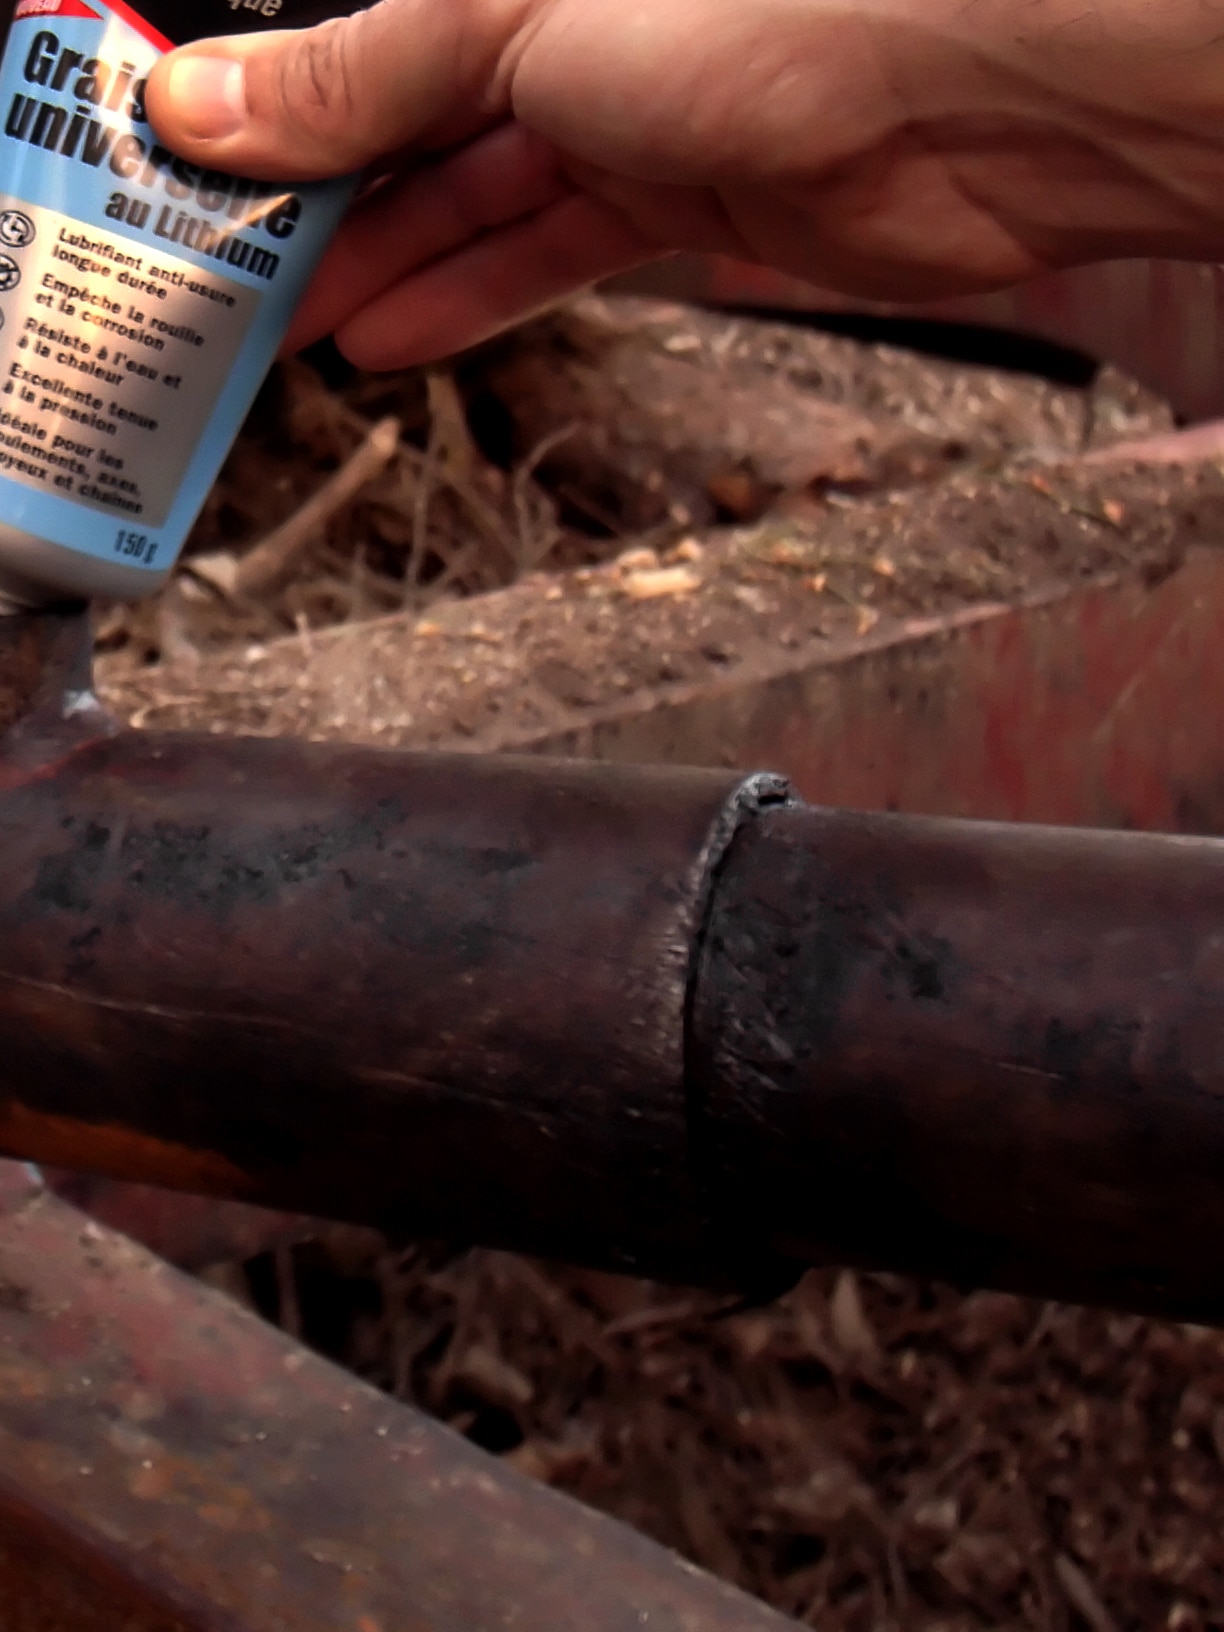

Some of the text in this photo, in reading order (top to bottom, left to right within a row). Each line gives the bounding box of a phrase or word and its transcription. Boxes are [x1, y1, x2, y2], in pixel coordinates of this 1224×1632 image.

[23, 30, 148, 124] Grais
[104, 192, 152, 230] au
[52, 244, 168, 300] longue durée
[59, 226, 236, 308] Lubrifiant anti-usure
[35, 291, 166, 351] et la corrosion
[42, 273, 205, 348] Empêche la rouille
[16, 335, 126, 386] à la chaleur
[25, 317, 182, 390] Résiste à l'eau et
[3, 379, 118, 436] à la pression
[9, 362, 159, 432] Excellente tenue
[51, 434, 96, 459] pour
[97, 448, 125, 470] les
[53, 473, 75, 491] et
